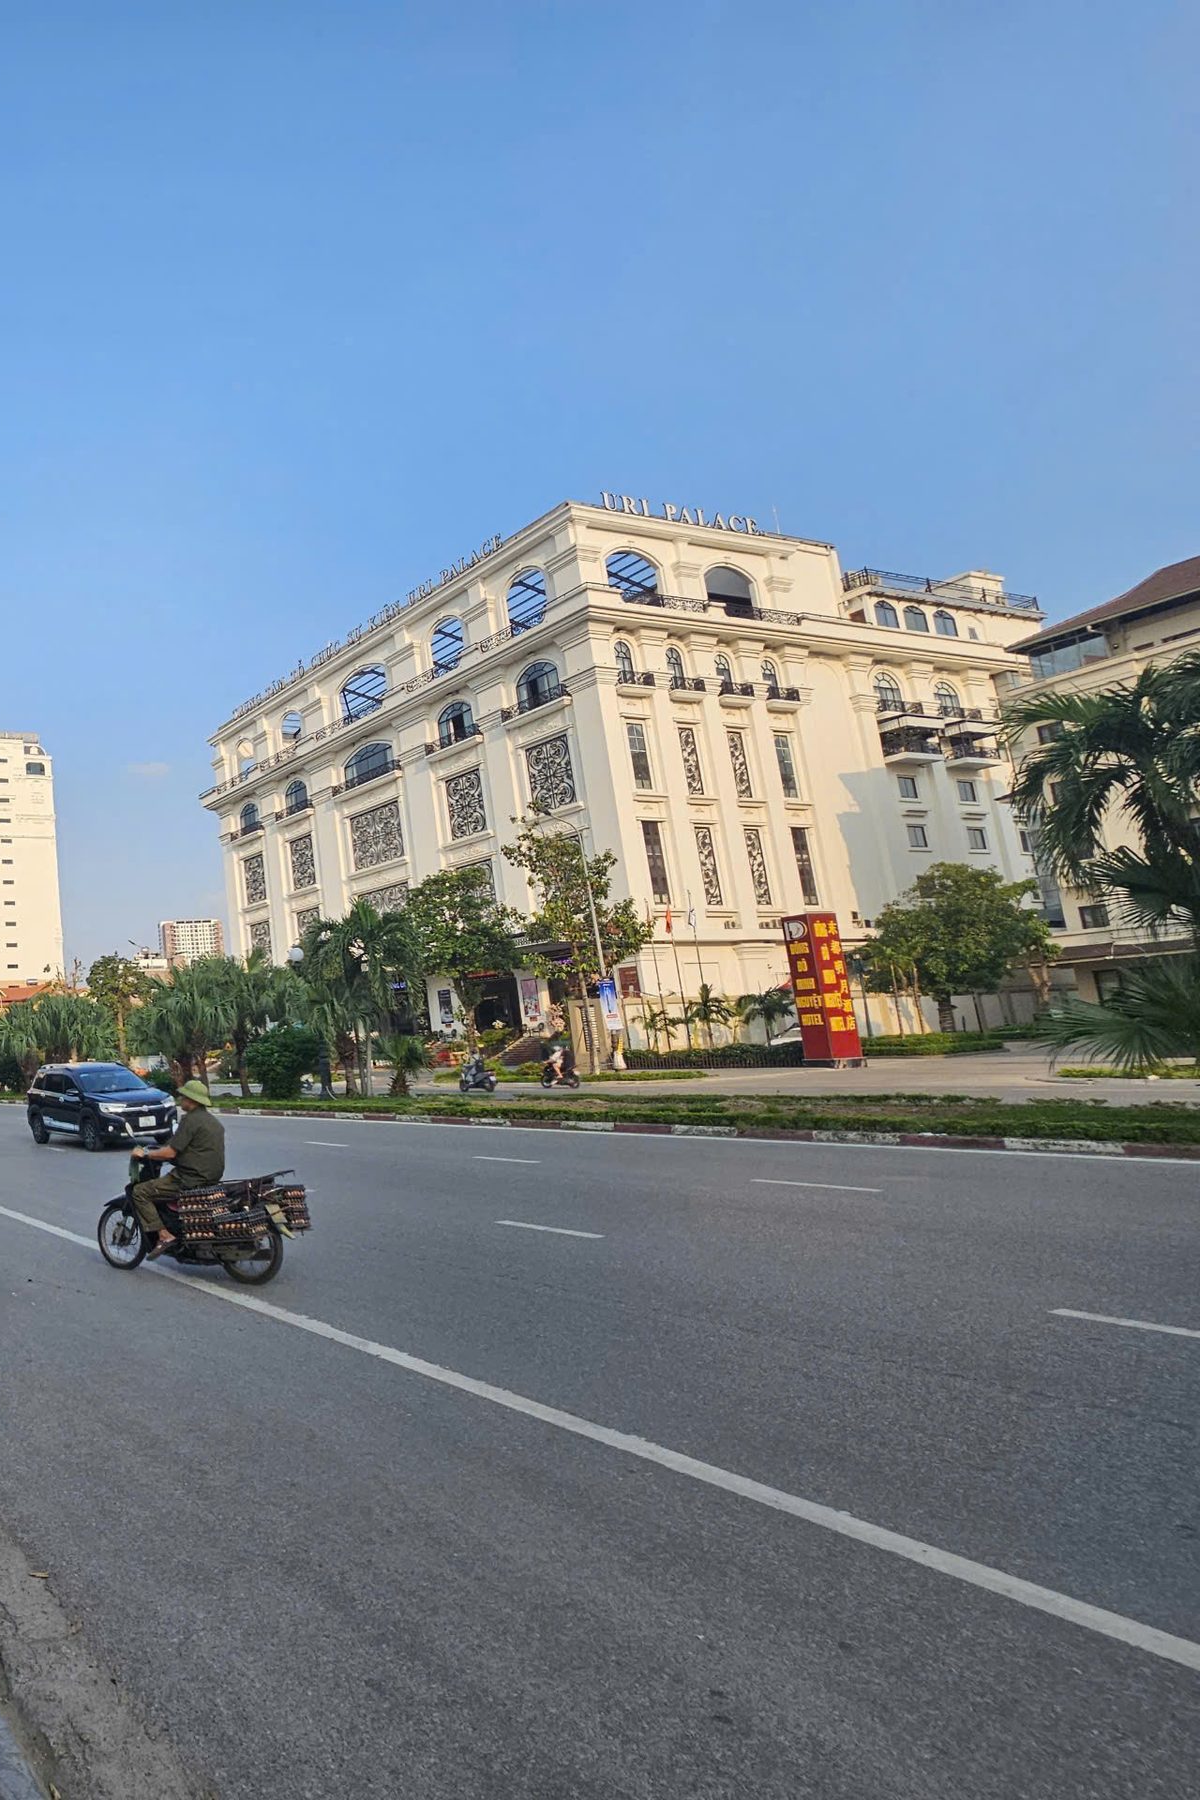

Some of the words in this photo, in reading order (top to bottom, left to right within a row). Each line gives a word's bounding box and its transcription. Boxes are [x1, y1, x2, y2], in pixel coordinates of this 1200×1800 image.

[600, 491, 650, 517] URI
[663, 502, 760, 536] PALACE
[367, 599, 402, 633] KIỆN
[406, 578, 433, 607] URI
[439, 532, 503, 586] PALACE
[801, 1013, 824, 1026] HOTEL
